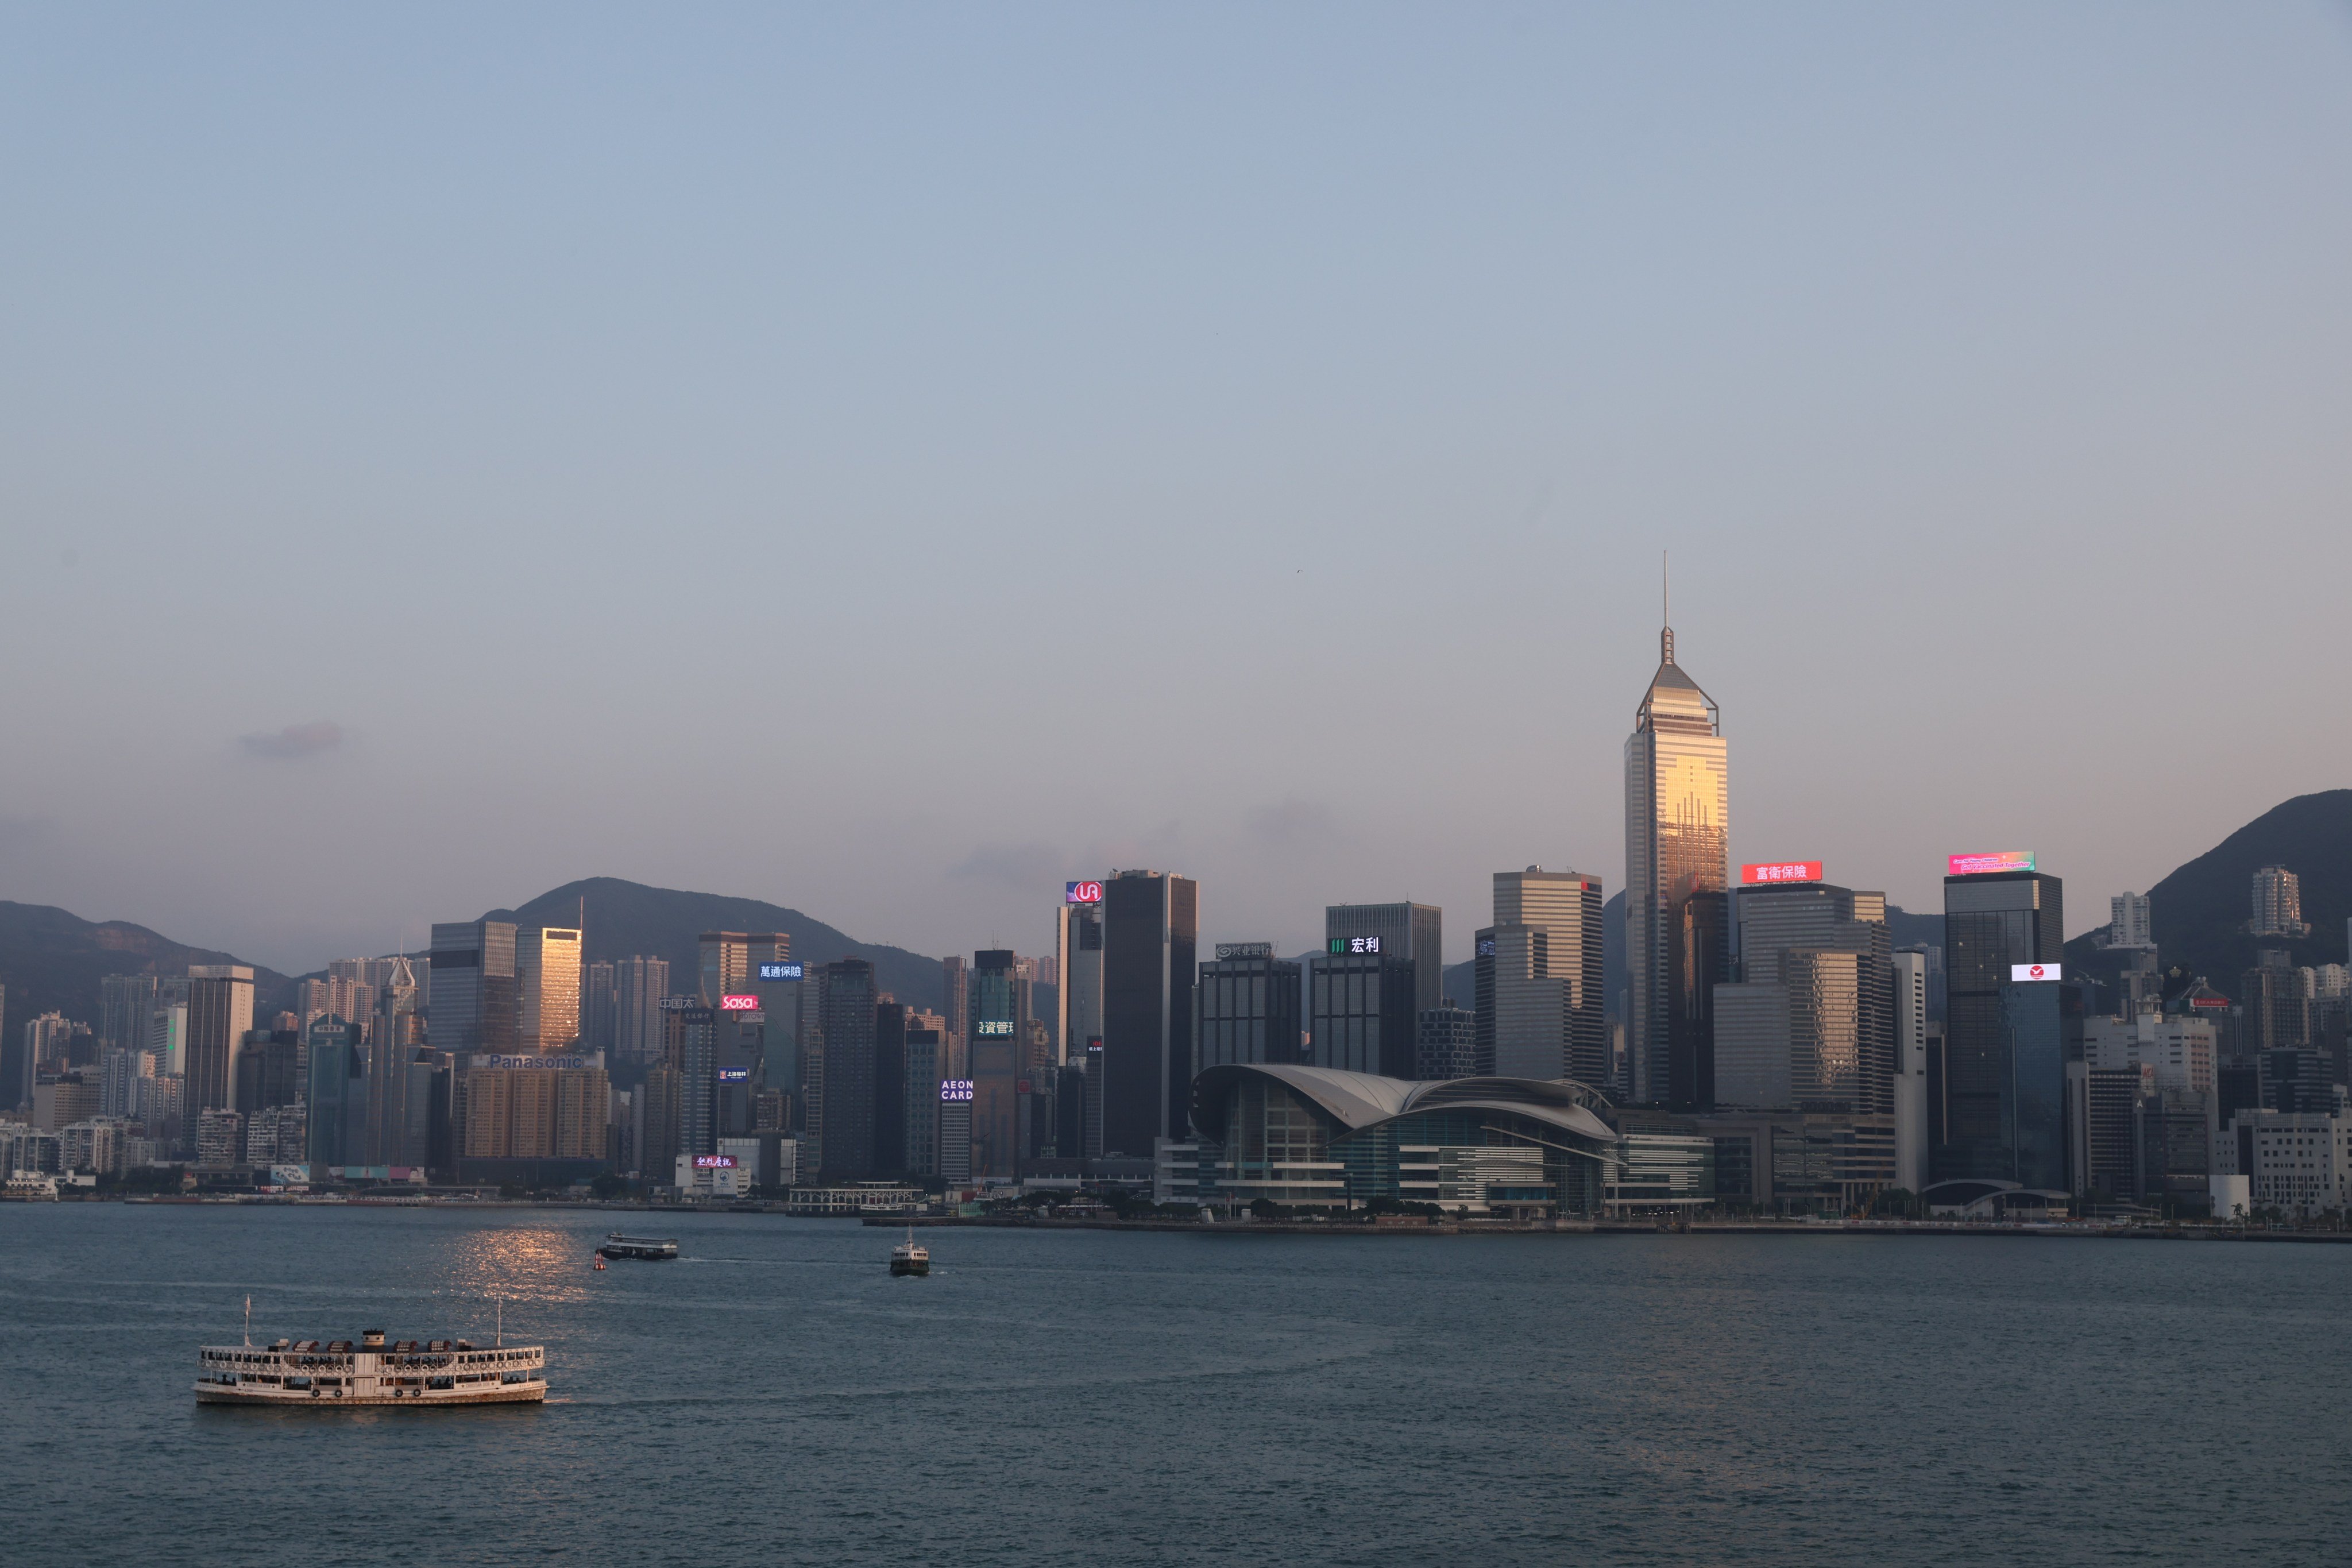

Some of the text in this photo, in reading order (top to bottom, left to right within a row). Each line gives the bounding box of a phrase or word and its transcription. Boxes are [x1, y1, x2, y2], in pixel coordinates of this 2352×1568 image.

[1756, 865, 1806, 880] 富衛保險
[1232, 945, 1270, 956] 兴业银行
[1351, 937, 1378, 952] 宏利
[760, 965, 801, 978] 萬通保險
[659, 998, 695, 1009] 中国太
[490, 1054, 582, 1069] Panasonic
[941, 1080, 974, 1089] AEON
[941, 1091, 973, 1099] CARD
